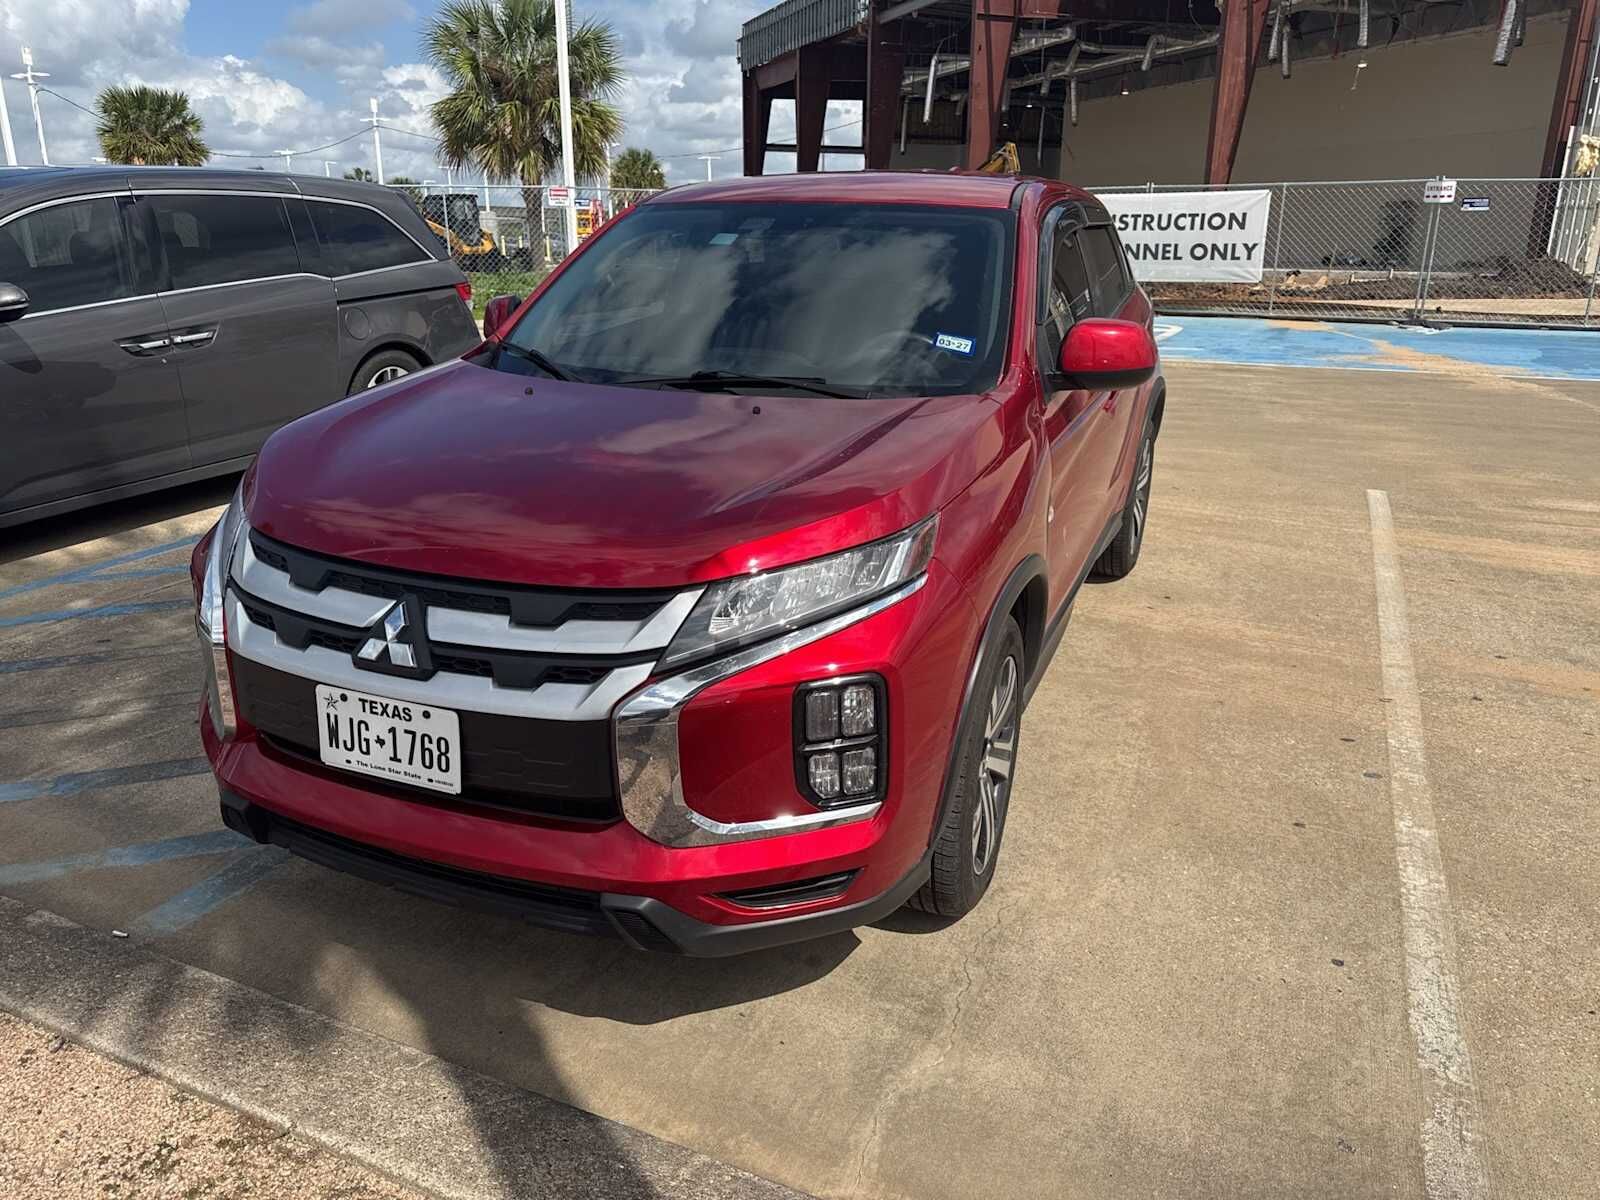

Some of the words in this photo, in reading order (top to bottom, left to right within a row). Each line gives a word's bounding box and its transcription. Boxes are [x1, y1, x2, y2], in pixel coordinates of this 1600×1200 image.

[1189, 243, 1259, 261] ONLY
[358, 698, 412, 722] TEXAS
[356, 760, 368, 768] The
[370, 763, 386, 771] Lone
[388, 767, 401, 775] Star
[404, 771, 421, 779] State
